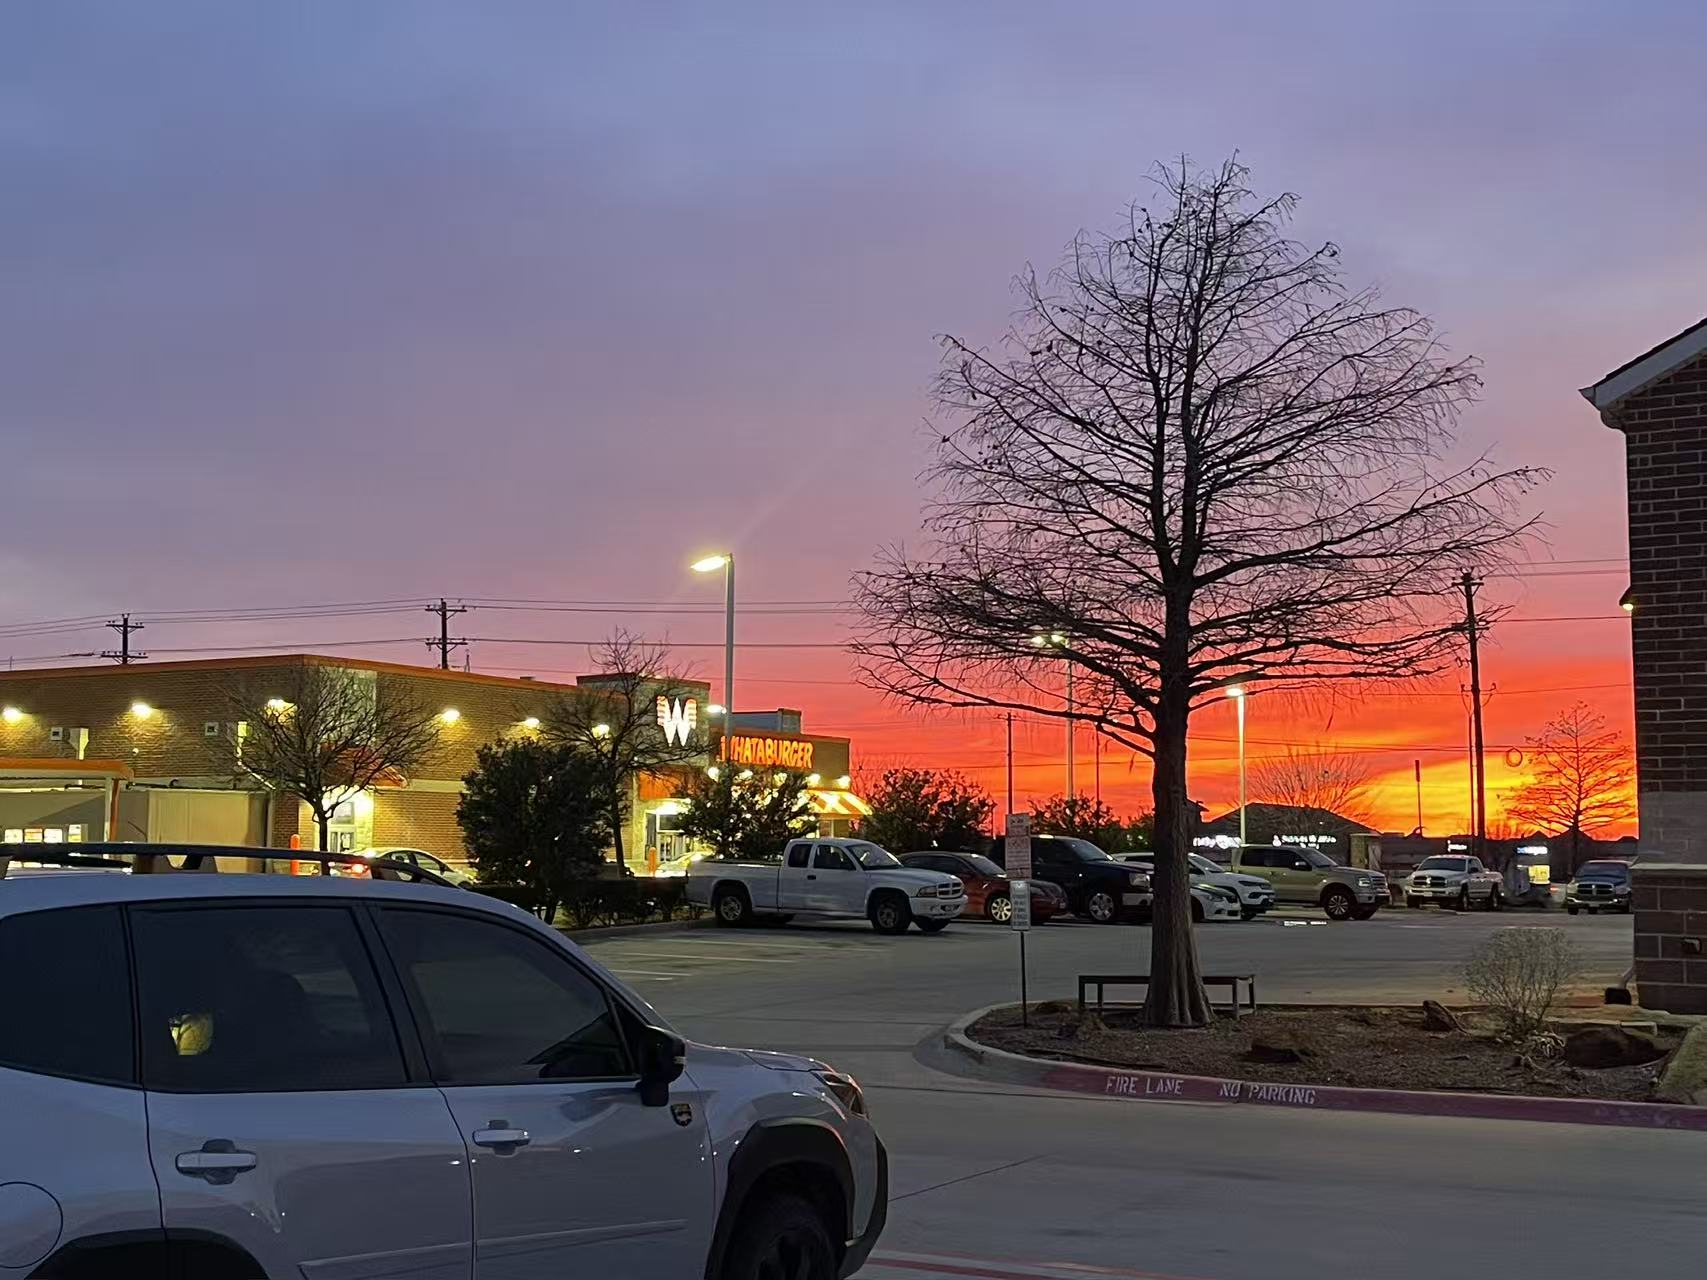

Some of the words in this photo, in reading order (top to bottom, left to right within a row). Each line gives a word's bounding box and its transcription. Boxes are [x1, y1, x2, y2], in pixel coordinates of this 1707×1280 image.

[656, 695, 697, 747] W
[1105, 1075, 1137, 1095] FIRE
[1146, 1077, 1185, 1096] LANE
[1219, 1080, 1243, 1098] NO
[1249, 1084, 1316, 1105] PARKING
